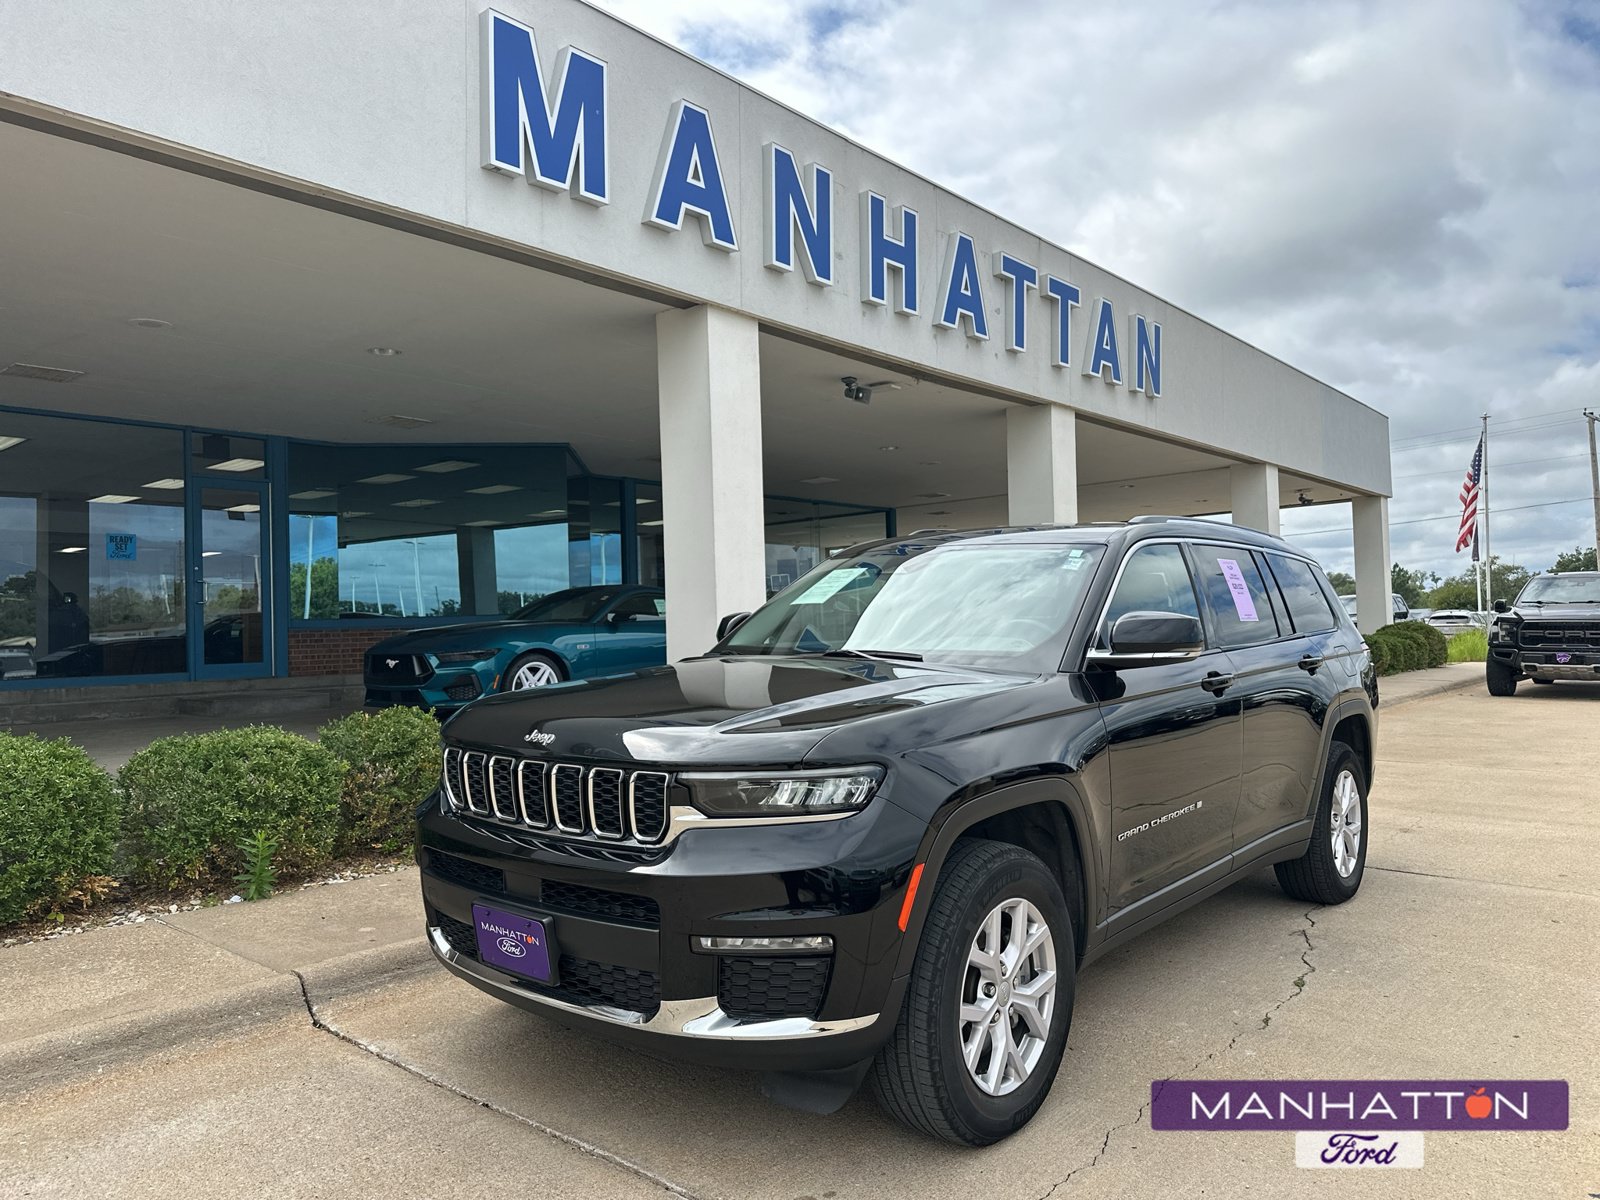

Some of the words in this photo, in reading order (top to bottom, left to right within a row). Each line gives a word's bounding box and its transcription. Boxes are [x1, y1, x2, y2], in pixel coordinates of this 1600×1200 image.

[480, 8, 1163, 398] MANHATTAN
[109, 535, 133, 544] READY
[114, 543, 128, 551] SET
[1521, 630, 1600, 638] FORD
[523, 729, 556, 746] Jeep
[1117, 822, 1150, 842] GRAND
[1150, 803, 1196, 828] CHEROKEE
[480, 921, 540, 946] MANHATTN
[501, 939, 521, 955] Ford
